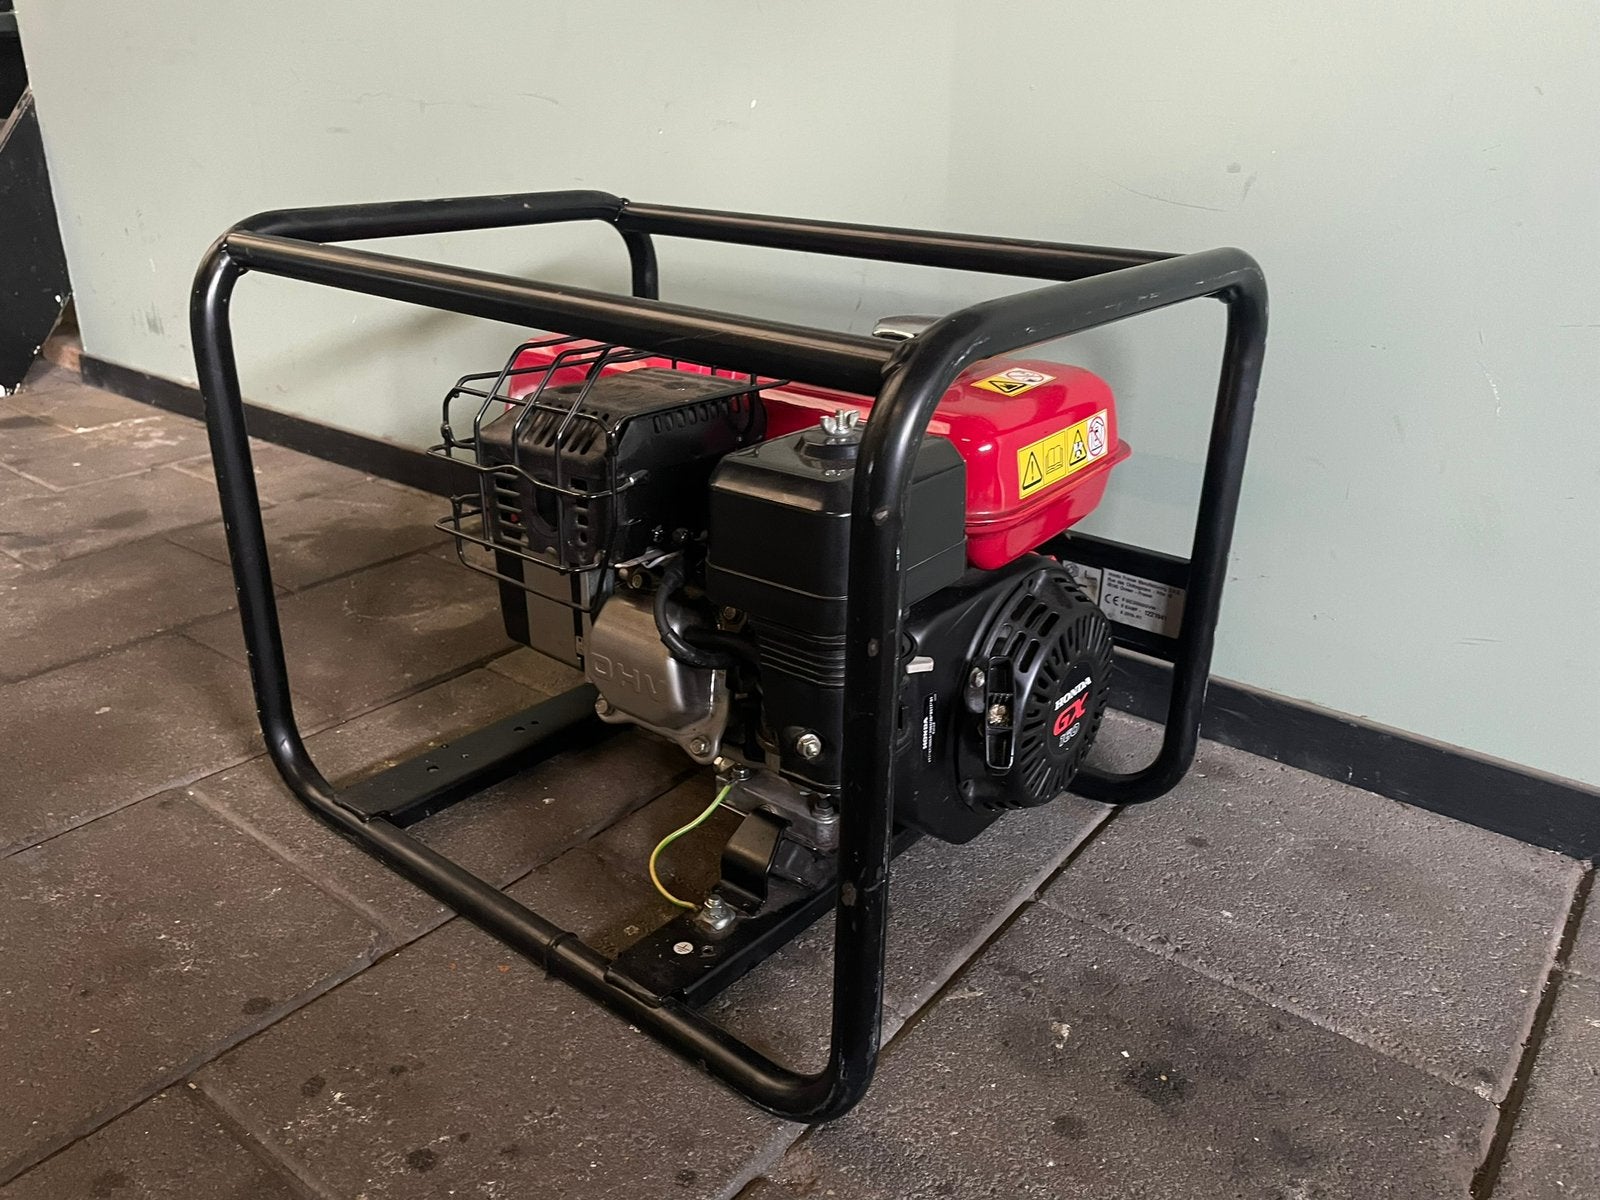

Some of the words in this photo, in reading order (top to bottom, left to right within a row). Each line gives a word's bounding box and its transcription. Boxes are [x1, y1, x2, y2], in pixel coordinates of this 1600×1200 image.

[1104, 593, 1119, 606] CE
[1054, 676, 1092, 711] HONDA
[1053, 691, 1089, 737] GX
